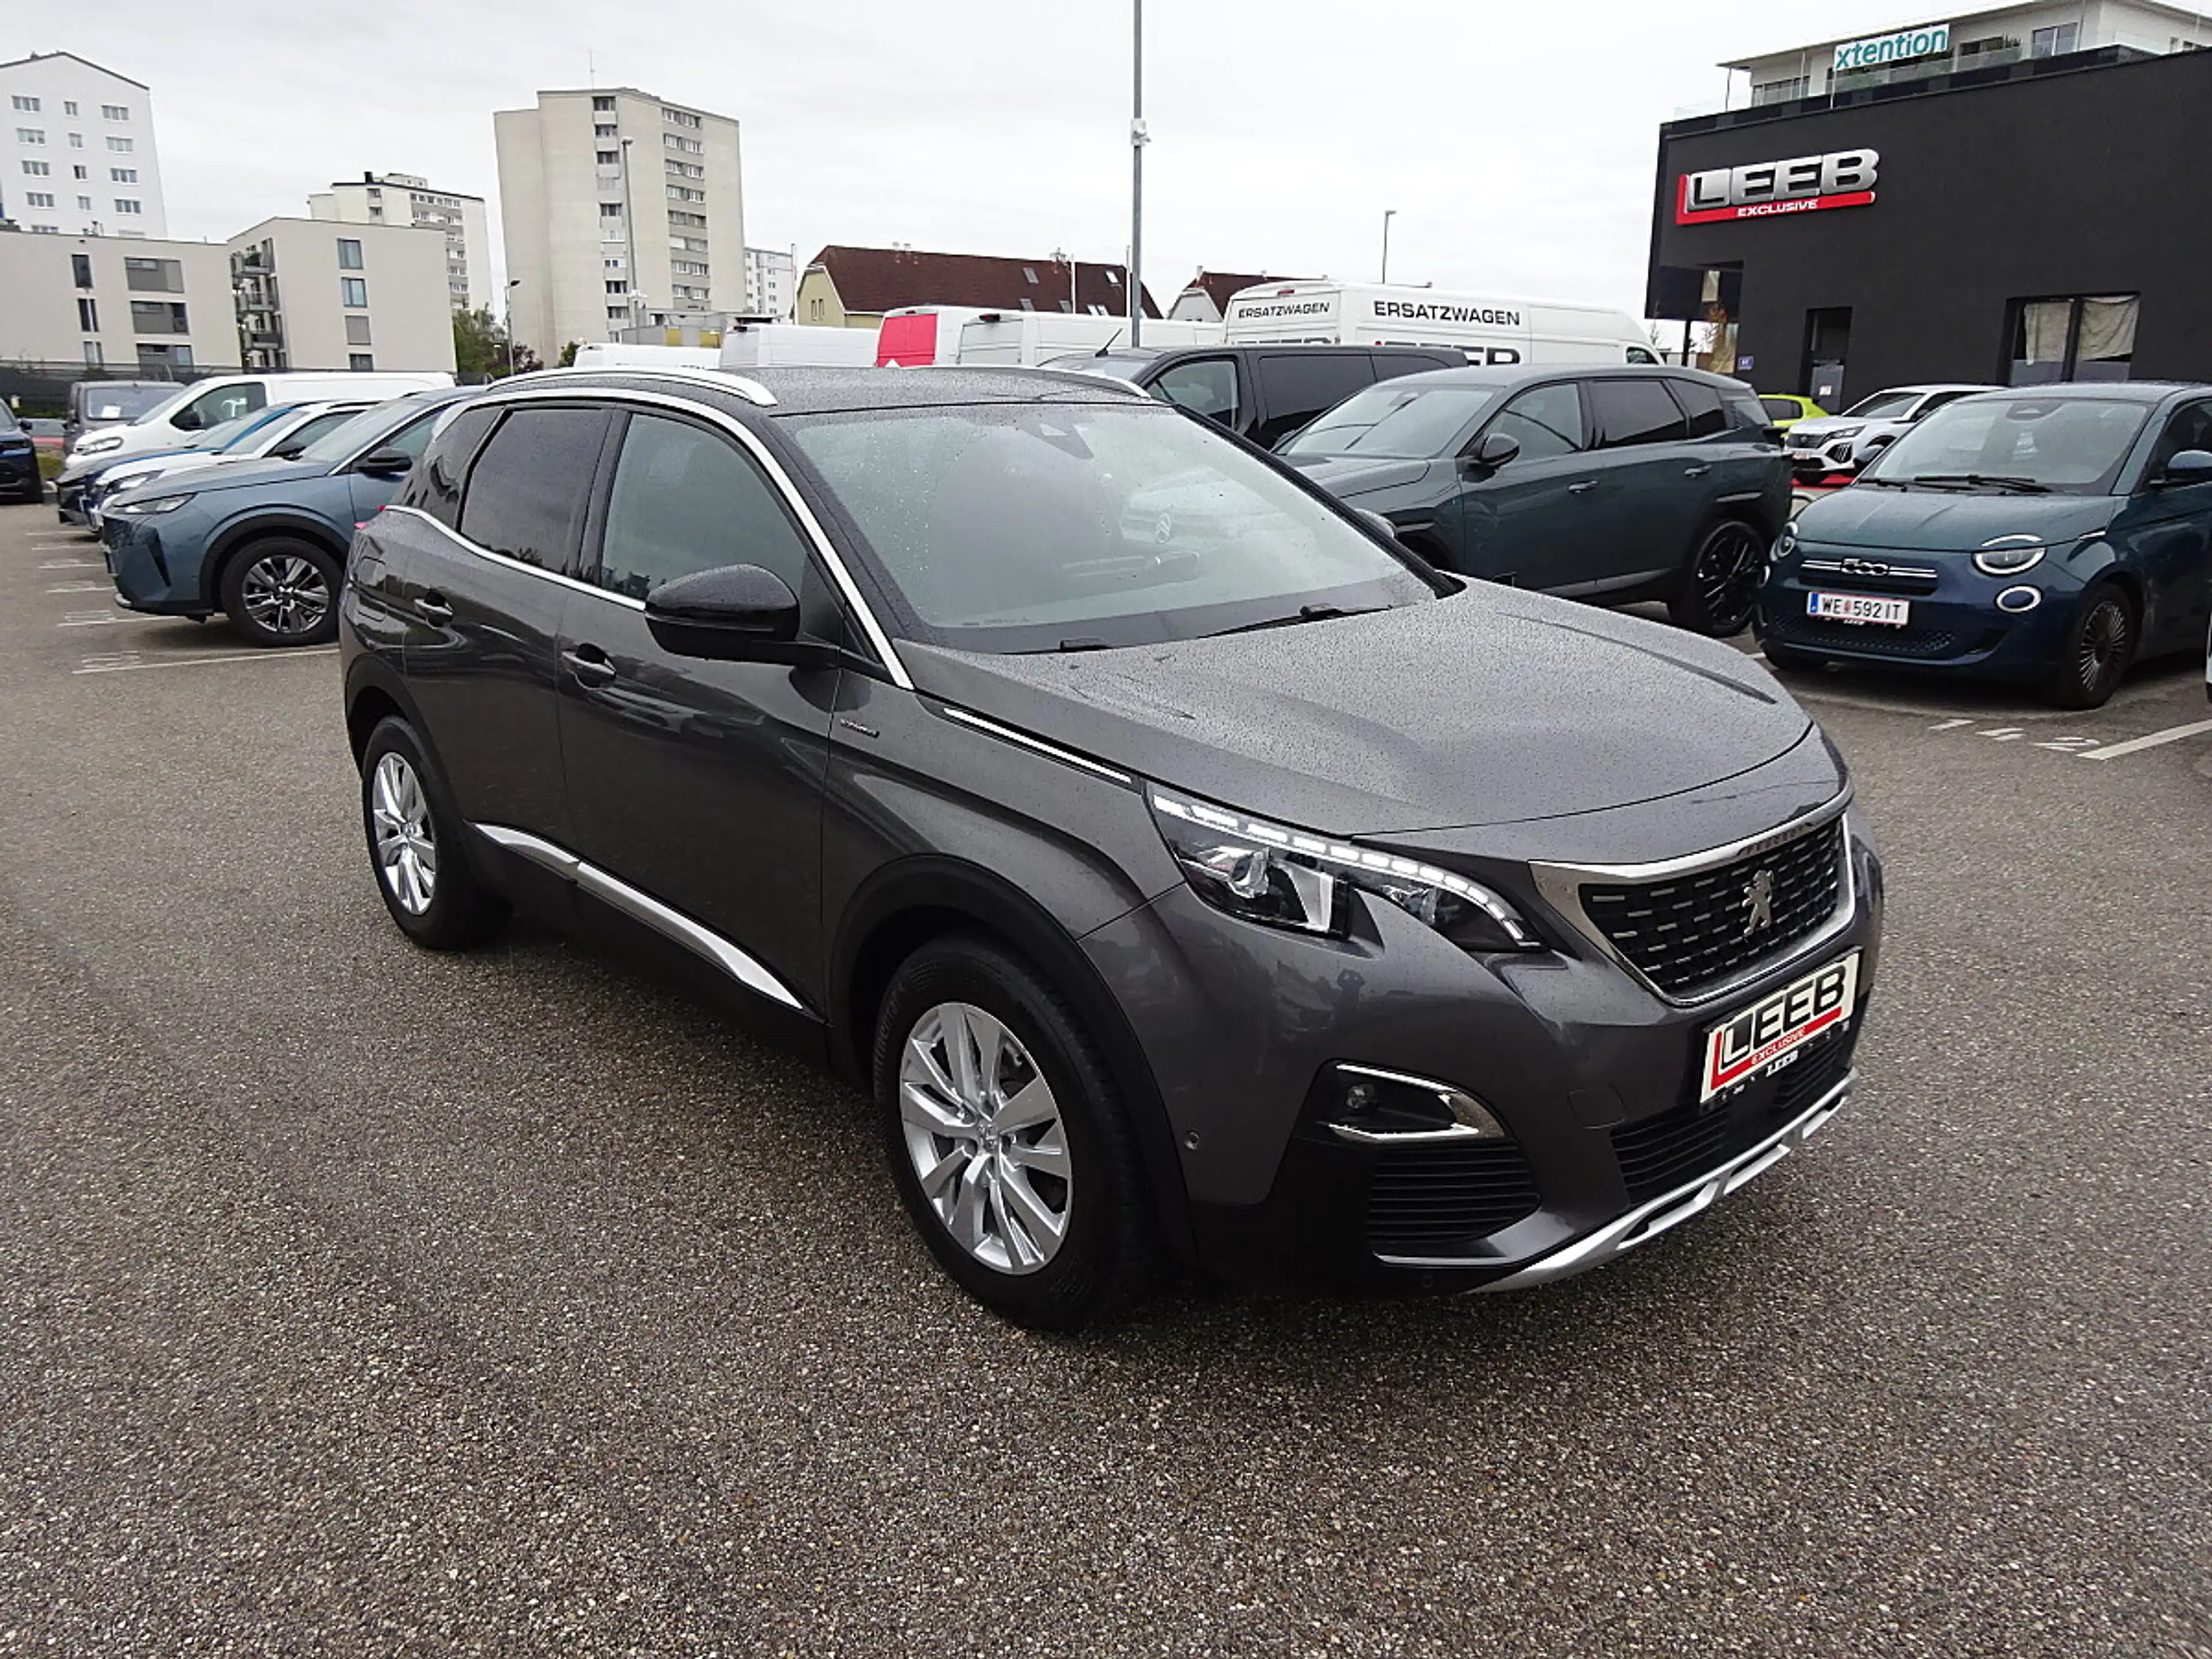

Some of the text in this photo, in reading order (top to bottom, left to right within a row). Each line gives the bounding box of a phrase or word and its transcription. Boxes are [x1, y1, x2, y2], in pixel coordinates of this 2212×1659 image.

[1836, 30, 1946, 68] xtention
[1688, 149, 1879, 211] LEEB
[1738, 200, 1817, 216] EXCLUSIVE
[1238, 302, 1330, 318] ERSATZWAGEN
[1374, 301, 1520, 325] ERSATZWAGEN
[1722, 965, 1846, 1069] LEEB
